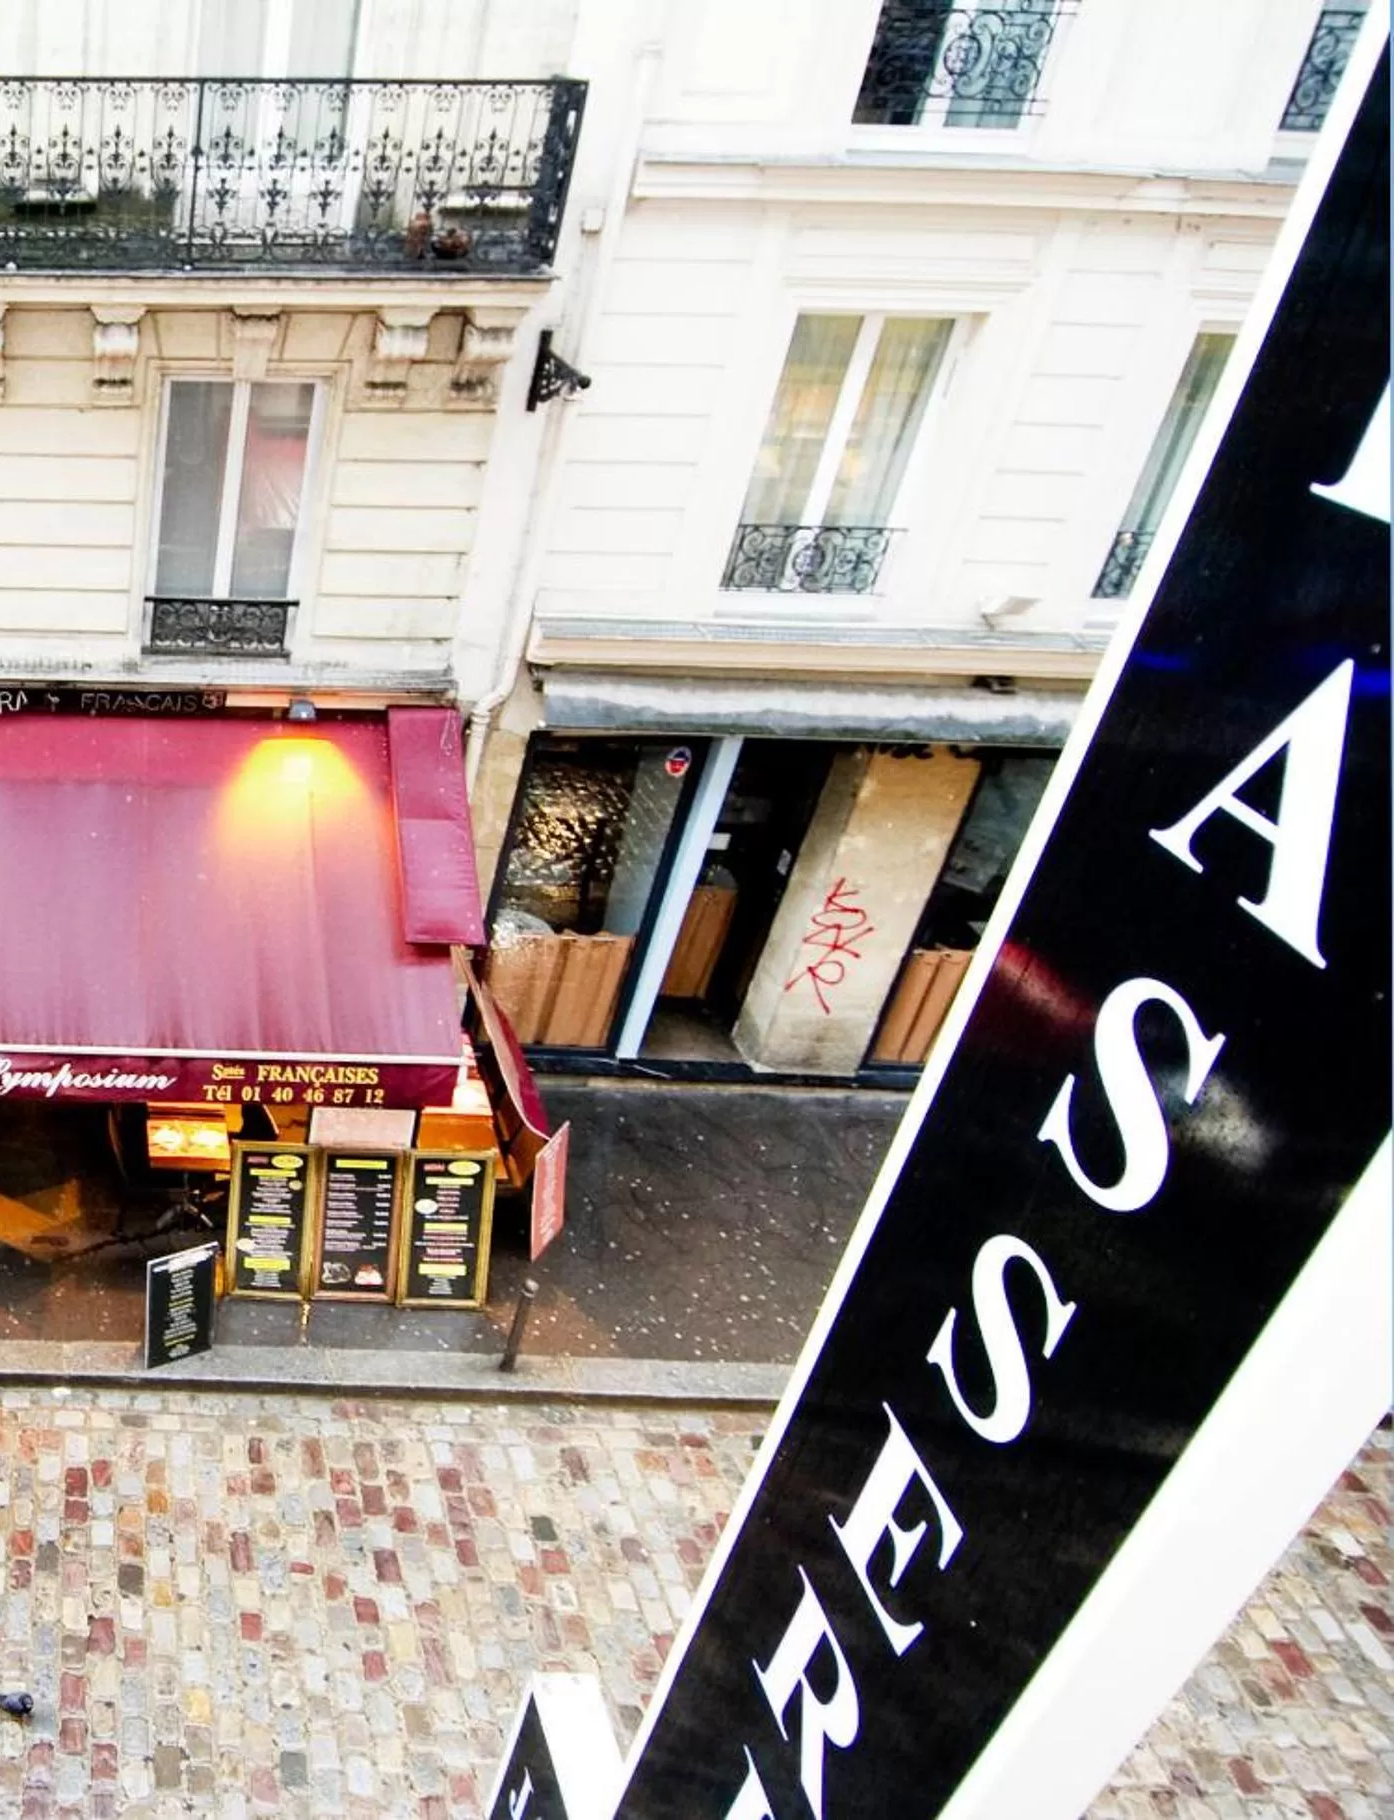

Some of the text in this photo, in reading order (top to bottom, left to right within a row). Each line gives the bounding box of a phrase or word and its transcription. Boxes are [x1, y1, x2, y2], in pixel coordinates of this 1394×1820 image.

[257, 1064, 379, 1088] FRANÇAISES
[202, 1085, 231, 1101] Tél
[241, 1086, 261, 1102] 01
[271, 1087, 293, 1102] 40
[334, 1088, 354, 1103] 87
[365, 1089, 385, 1104] 12
